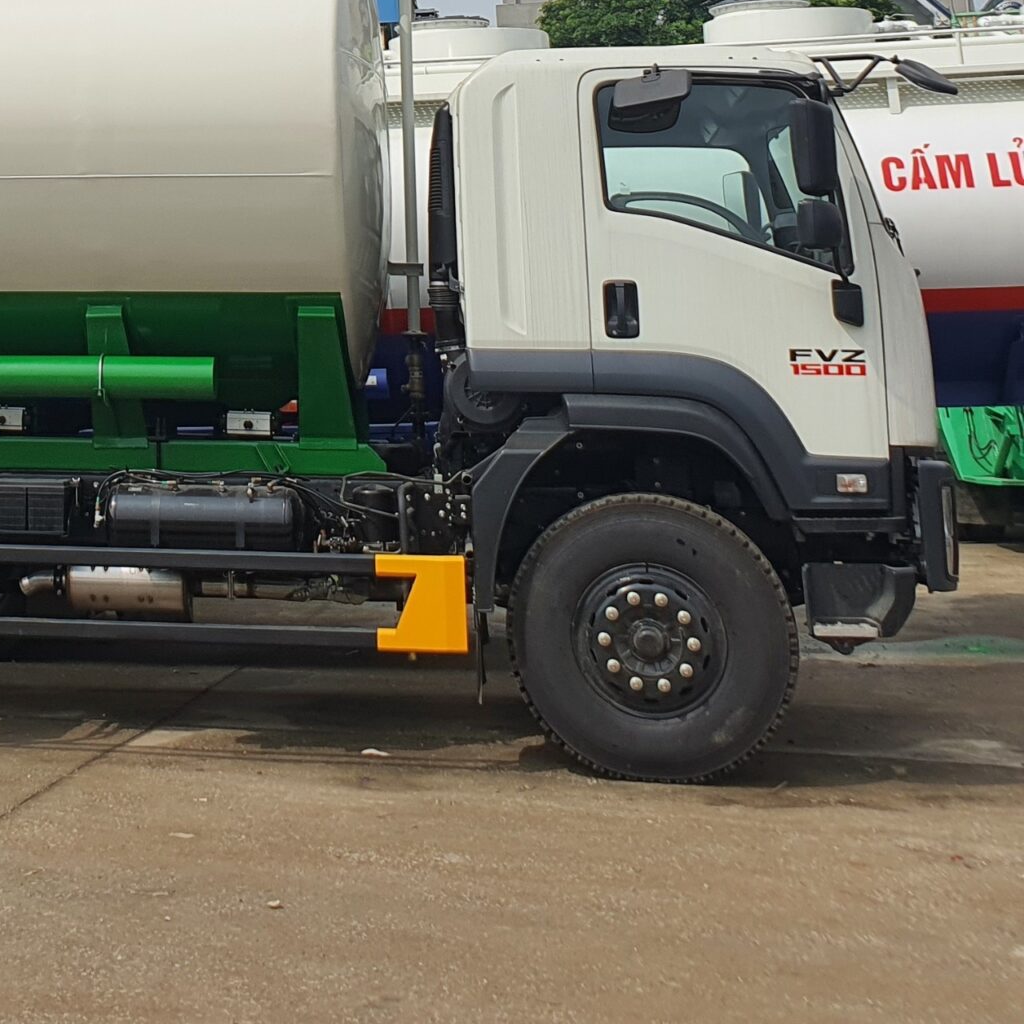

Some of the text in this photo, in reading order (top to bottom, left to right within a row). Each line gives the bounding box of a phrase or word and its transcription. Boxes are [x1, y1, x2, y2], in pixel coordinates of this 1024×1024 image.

[881, 143, 975, 193] CẤM
[789, 348, 866, 363] FVZ
[790, 363, 866, 376] 1500
